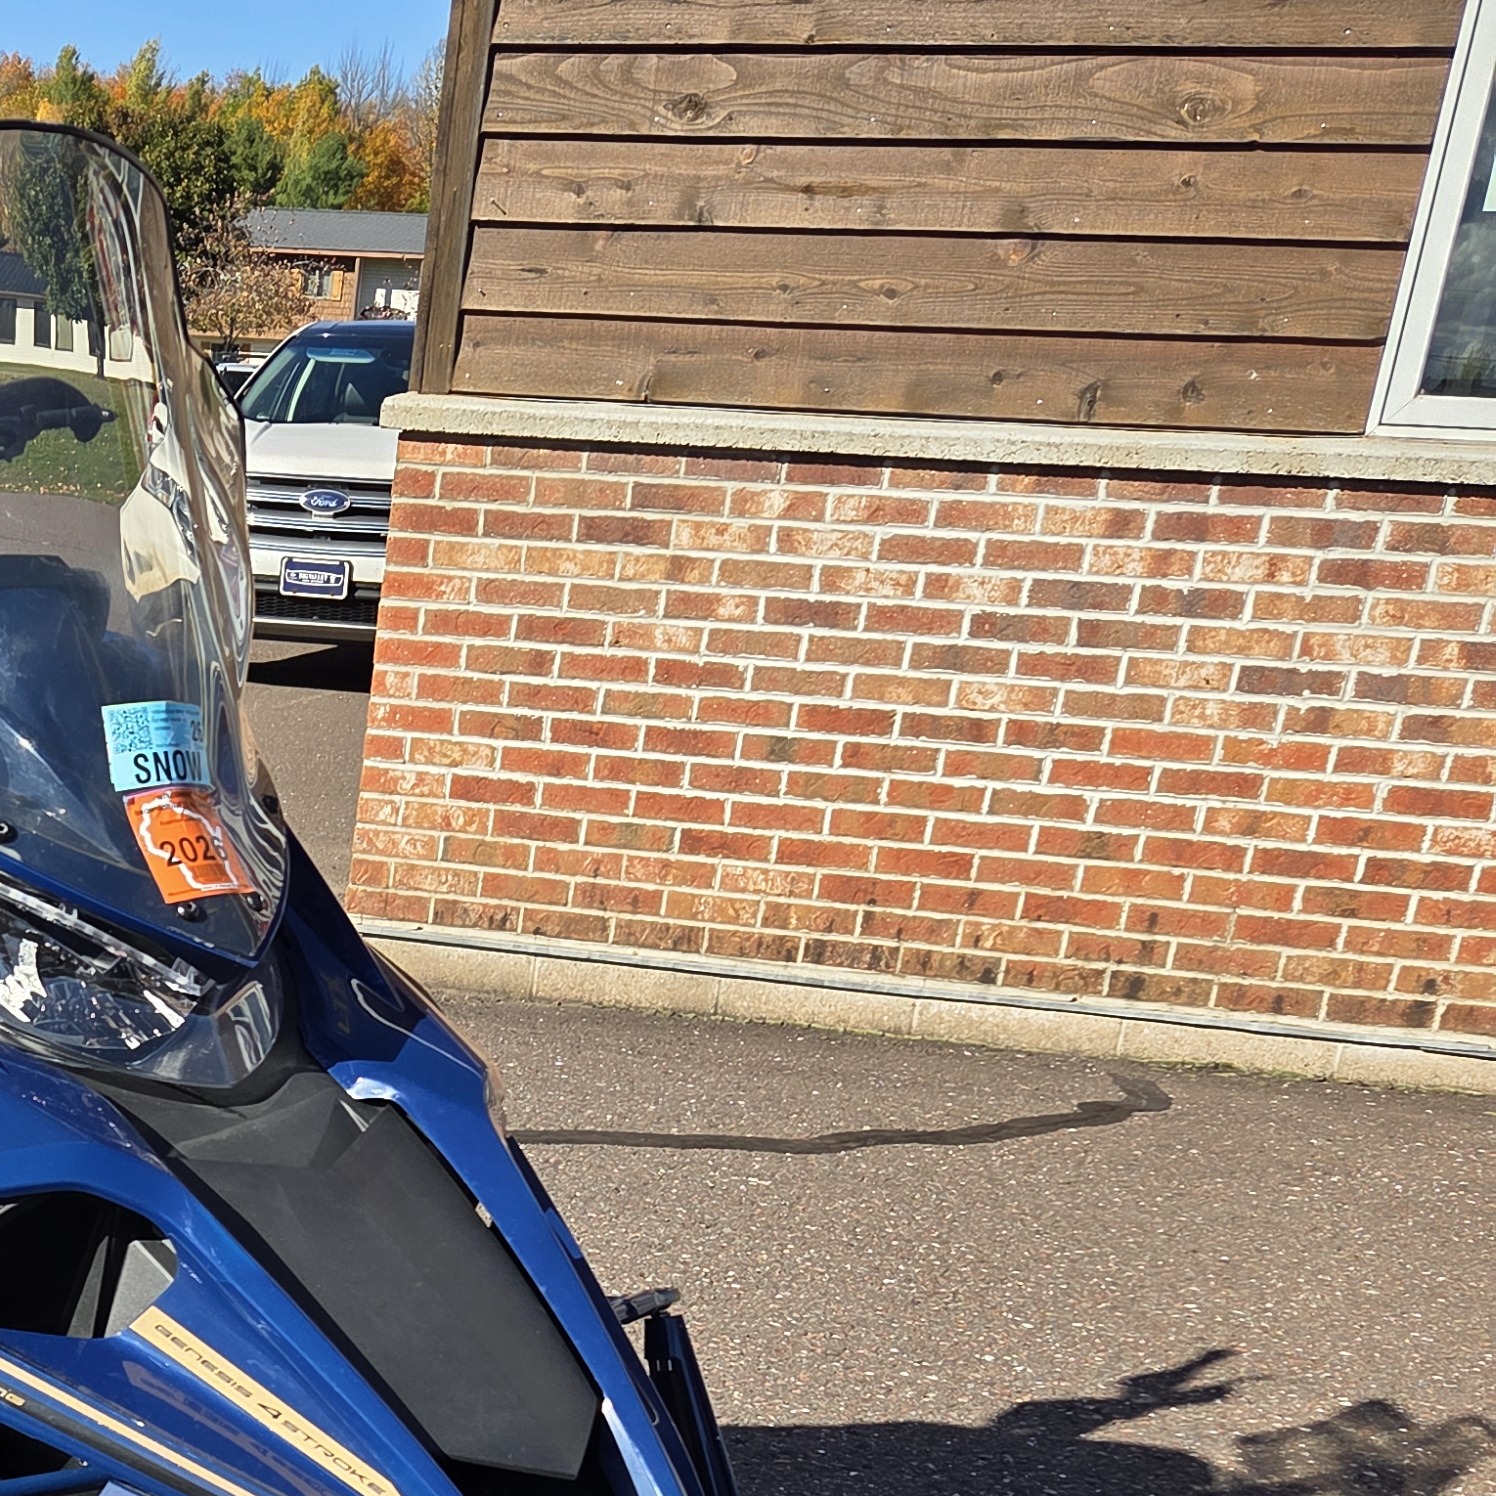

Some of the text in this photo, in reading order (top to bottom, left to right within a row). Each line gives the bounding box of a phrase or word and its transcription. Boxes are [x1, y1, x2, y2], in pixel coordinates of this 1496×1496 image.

[310, 494, 338, 508] Ford
[133, 749, 202, 784] SNOW
[154, 1323, 253, 1398] GENESIS
